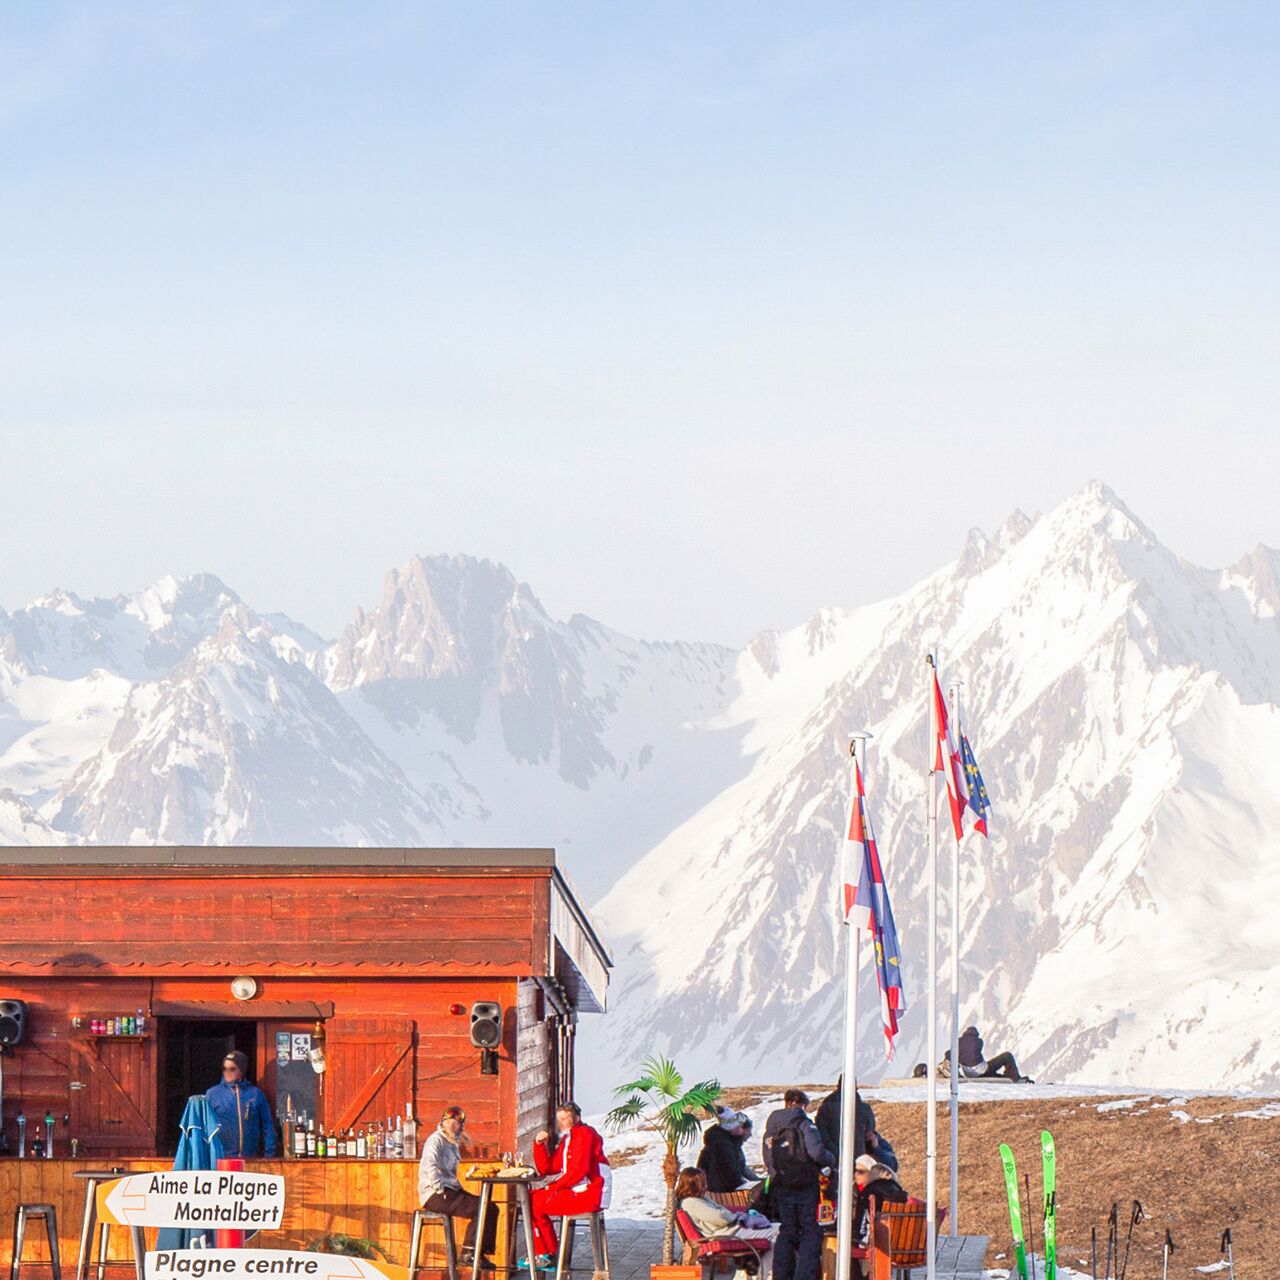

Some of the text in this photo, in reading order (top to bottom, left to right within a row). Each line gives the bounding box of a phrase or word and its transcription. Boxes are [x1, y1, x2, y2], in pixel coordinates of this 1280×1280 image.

[148, 1174, 278, 1201] Aime La Plagne
[174, 1201, 280, 1222] Montalbert
[154, 1253, 318, 1278] Plagne centre
